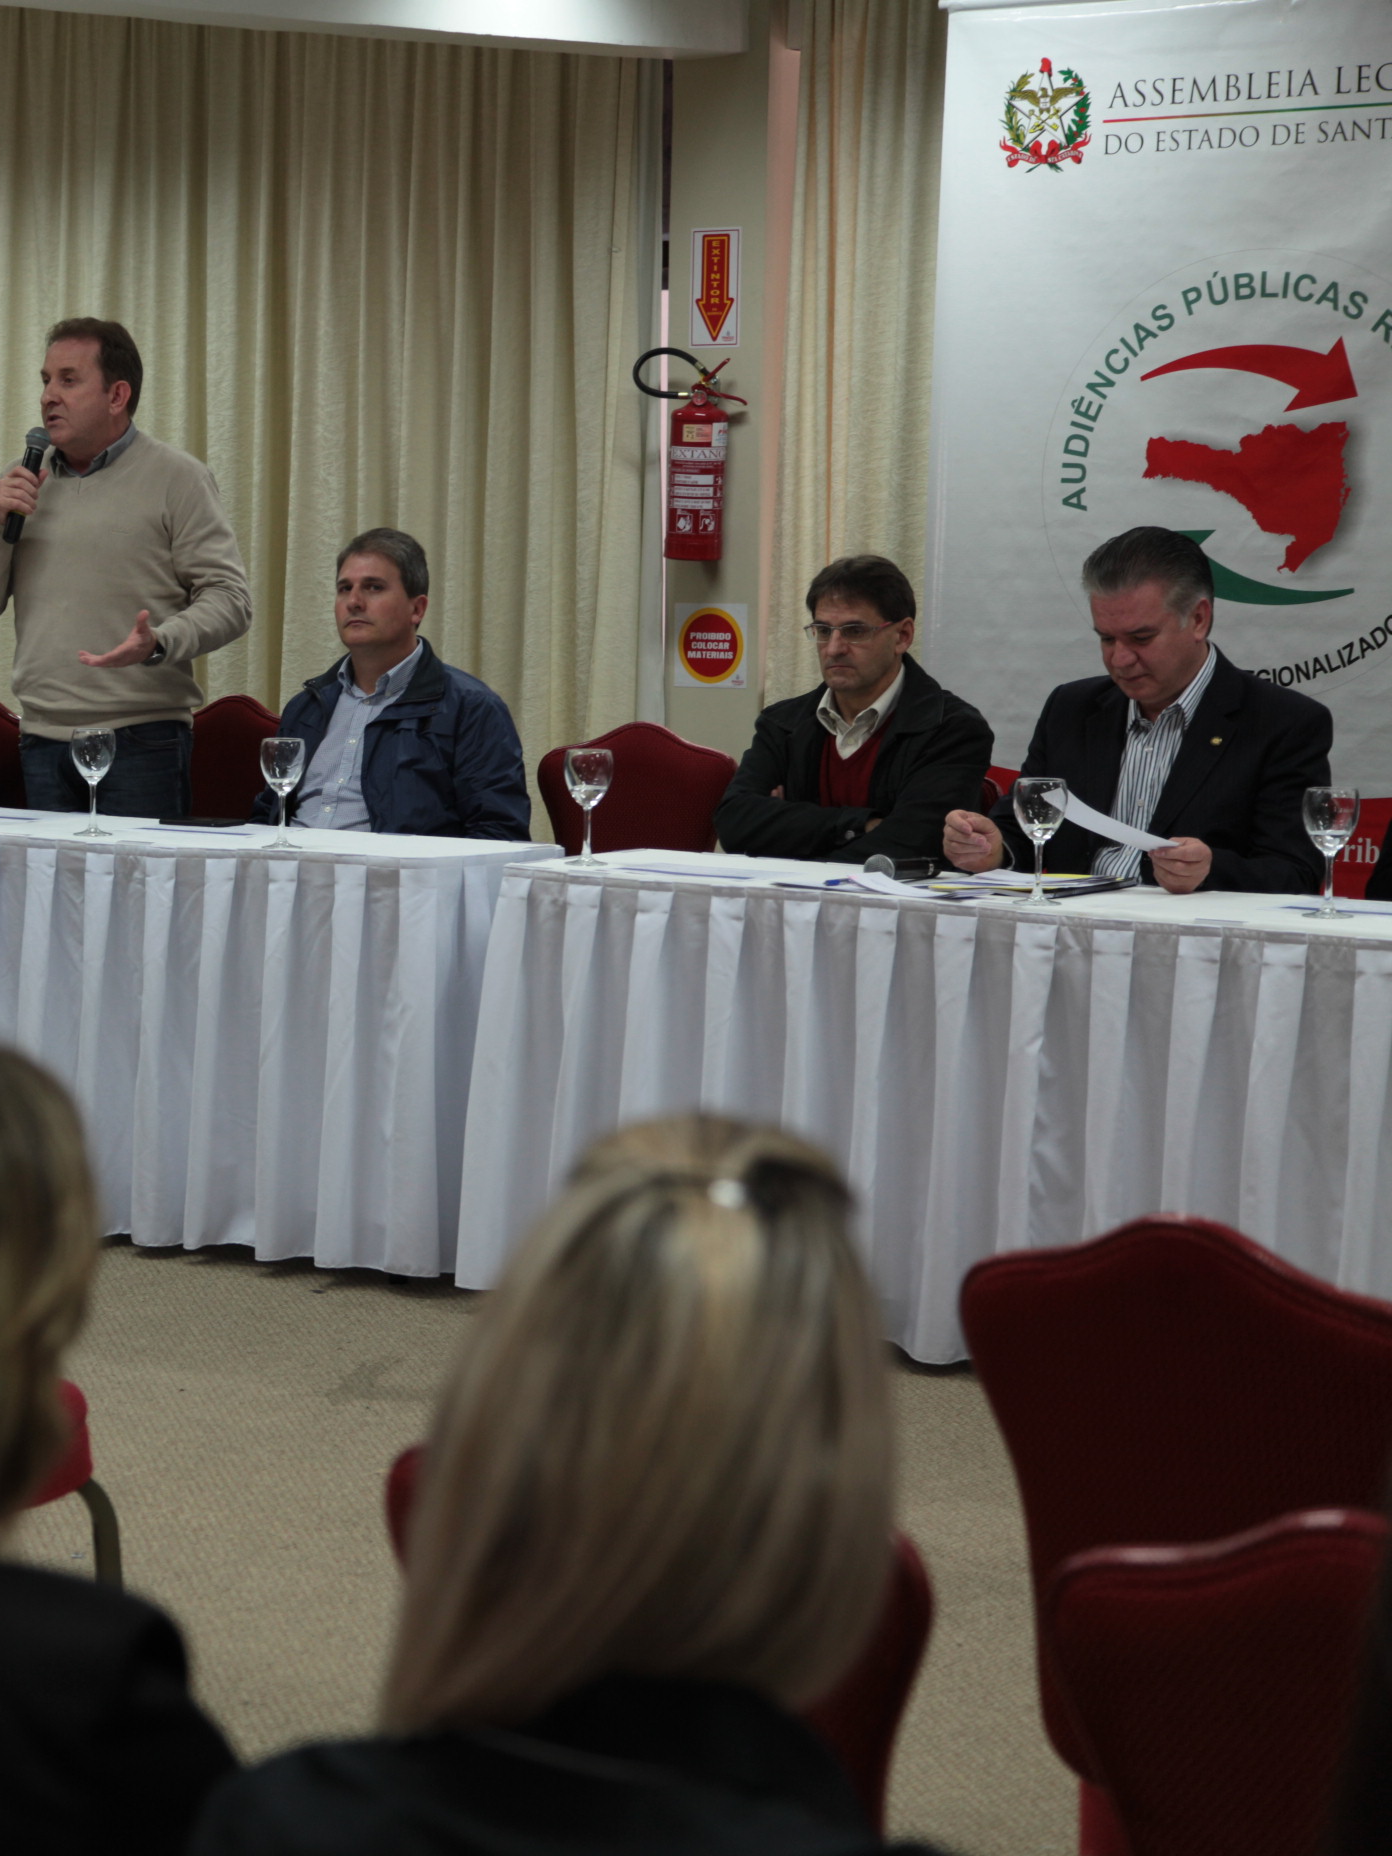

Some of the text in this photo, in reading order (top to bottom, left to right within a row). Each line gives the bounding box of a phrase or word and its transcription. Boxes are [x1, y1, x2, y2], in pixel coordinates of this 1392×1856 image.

[1107, 69, 1320, 109] ASSEMBLEIA
[1103, 116, 1392, 155] DO ESTADO DE SANT
[710, 240, 721, 304] EXTINTOR
[1060, 304, 1176, 512] AUDIÊNCIAS
[1181, 270, 1369, 319] PÚBLICAS
[689, 632, 732, 641] PROIBIDO
[691, 641, 730, 650] COLOCAR
[687, 650, 734, 659] MATERIAIS
[1335, 837, 1380, 864] rib
